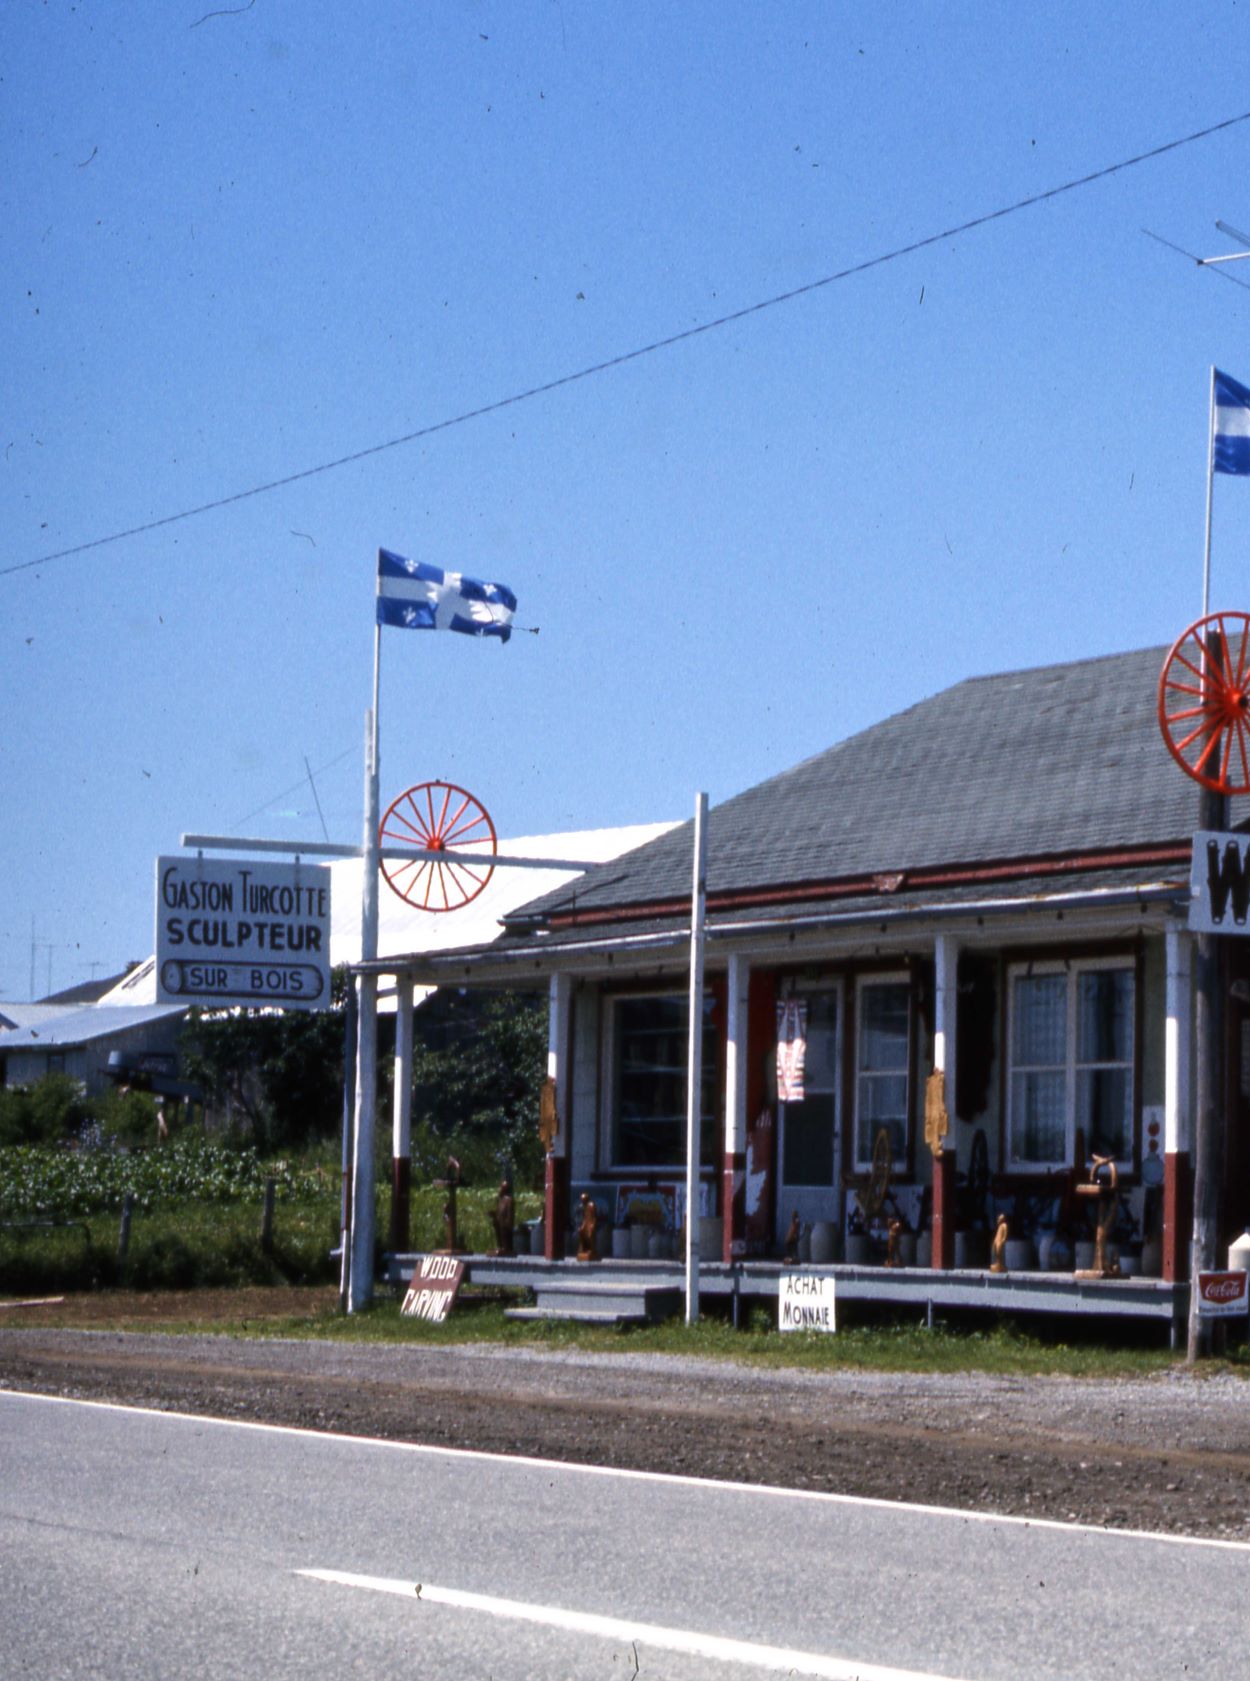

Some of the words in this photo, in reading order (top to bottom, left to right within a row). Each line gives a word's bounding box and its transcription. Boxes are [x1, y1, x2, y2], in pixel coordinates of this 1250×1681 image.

[163, 867, 233, 913] GASTON
[239, 871, 326, 918] TURCOTTE
[167, 918, 322, 952] SCULPTEUR
[190, 967, 228, 988] SUR
[251, 970, 303, 991] BOIS
[420, 1256, 458, 1279] WOOD
[786, 1273, 825, 1295] ACHAT
[783, 1301, 830, 1325] MONNAIE
